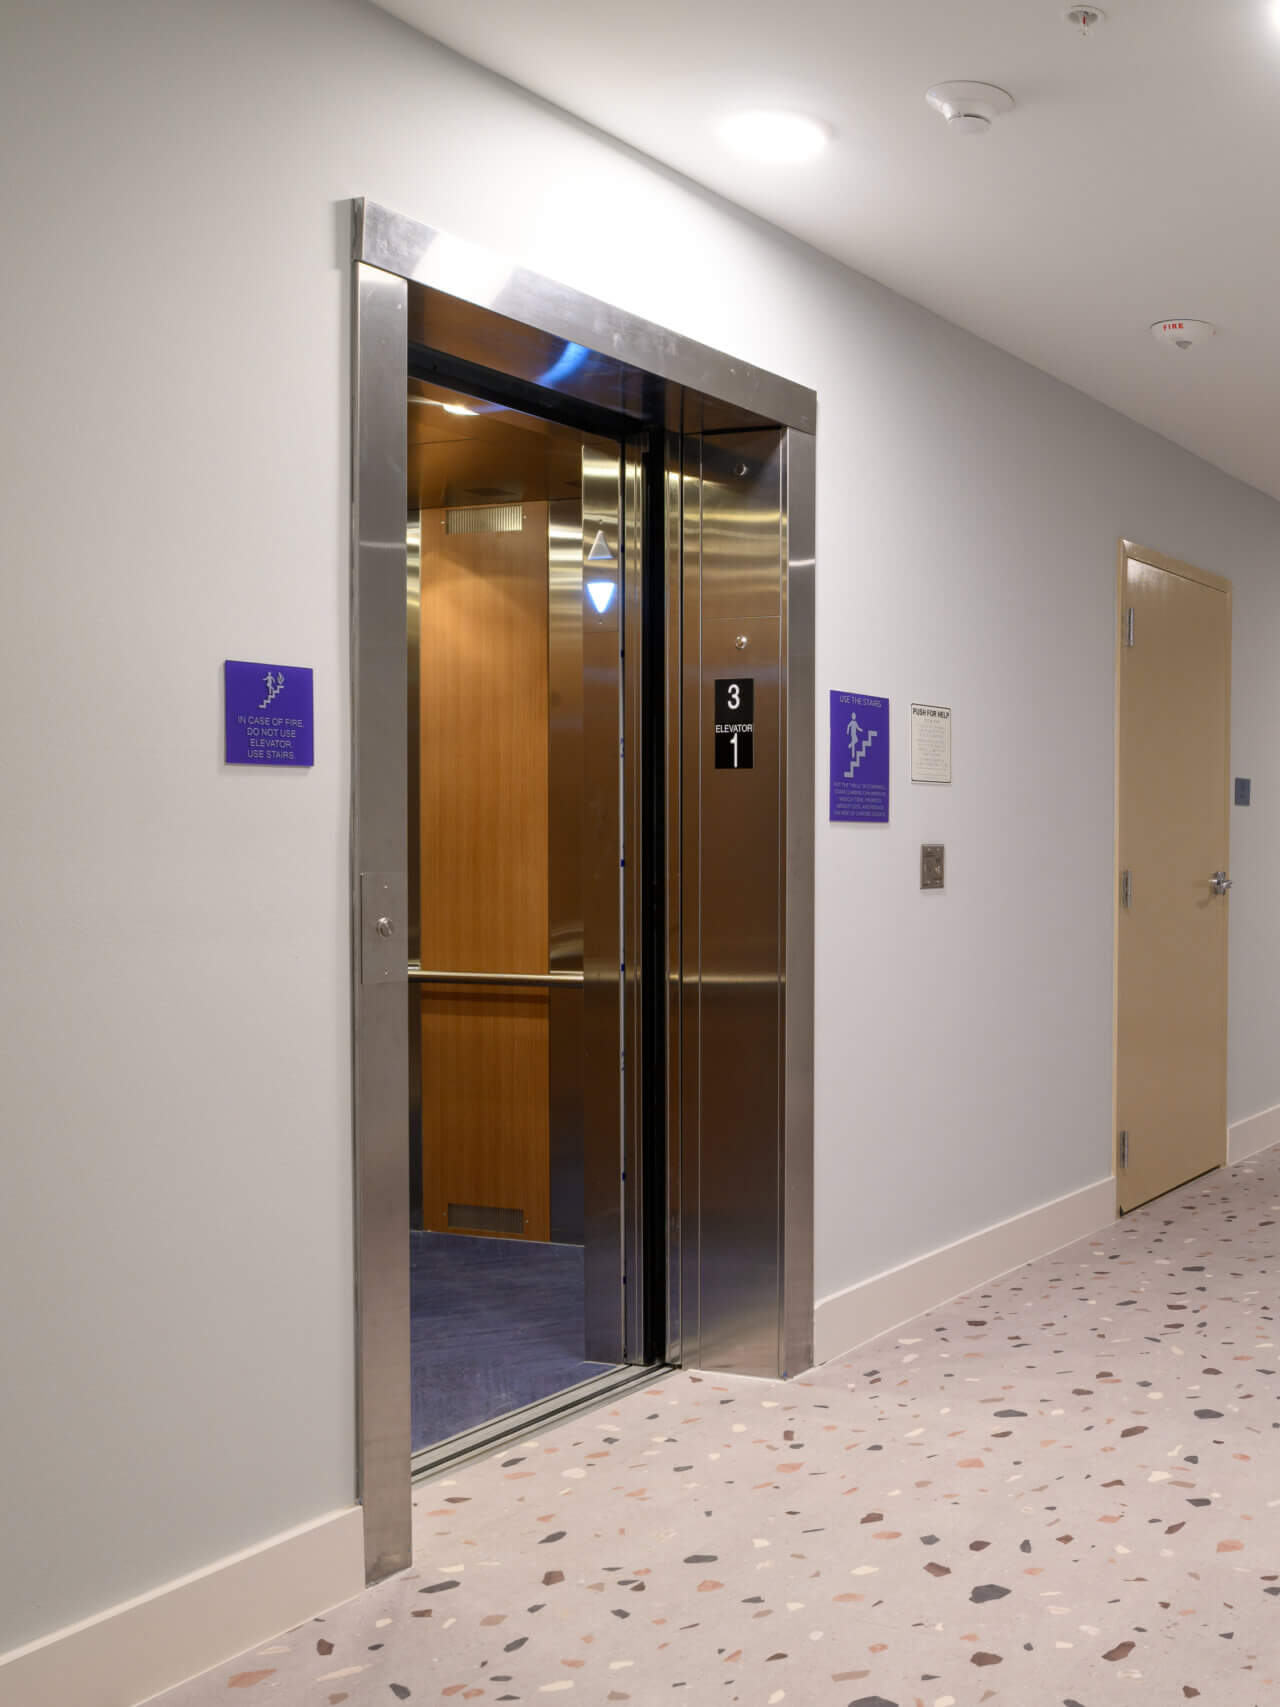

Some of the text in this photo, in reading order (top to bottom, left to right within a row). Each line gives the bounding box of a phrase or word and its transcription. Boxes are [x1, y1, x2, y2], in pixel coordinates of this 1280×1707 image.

[1162, 322, 1184, 331] FIRE
[728, 684, 740, 710] 3
[912, 707, 950, 719] PUSH FOR HELP
[238, 715, 246, 724] IN
[248, 716, 271, 725] CASE
[271, 717, 283, 726] OF
[247, 727, 296, 738] DO NOT USE
[715, 723, 753, 733] ELEVATOR
[247, 749, 264, 759] USE
[729, 733, 738, 769] 1
